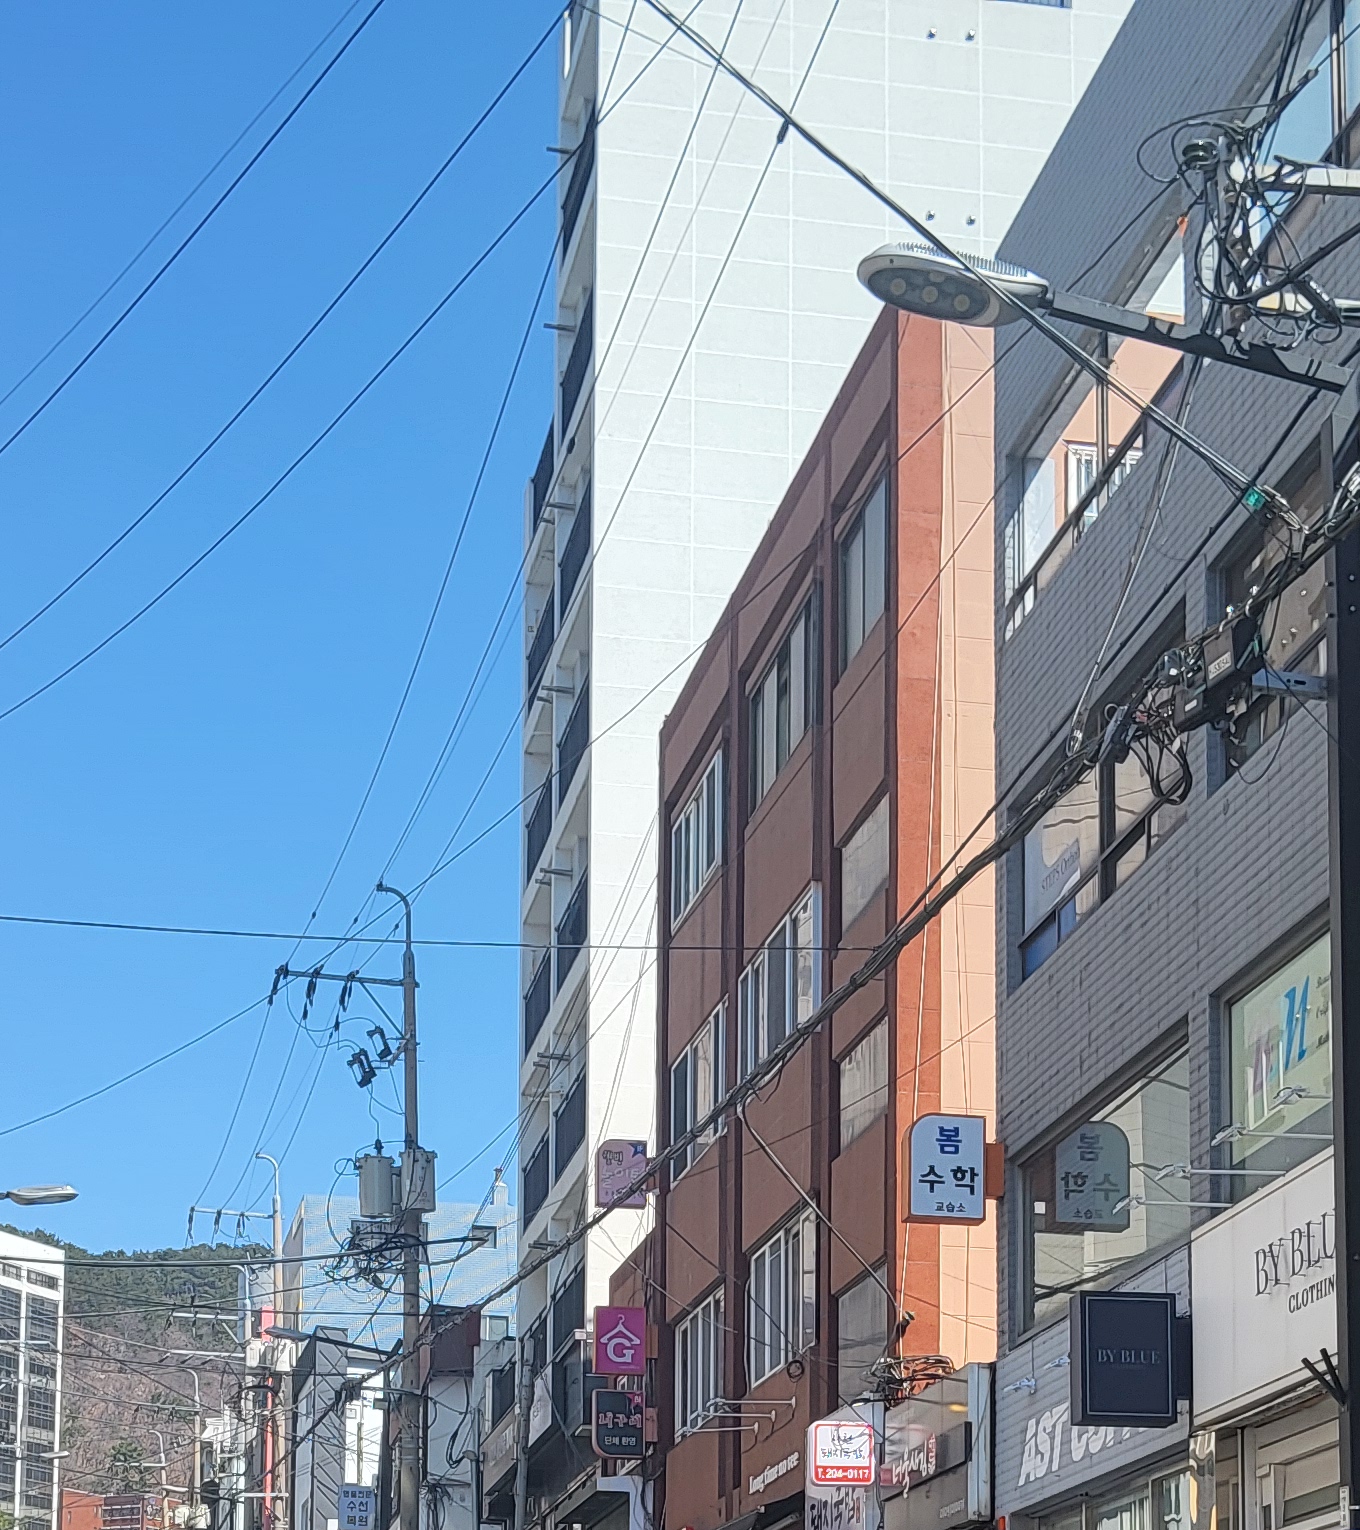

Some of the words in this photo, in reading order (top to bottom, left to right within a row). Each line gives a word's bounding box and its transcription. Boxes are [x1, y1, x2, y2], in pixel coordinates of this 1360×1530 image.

[935, 1125, 962, 1155] 봄
[918, 1165, 979, 1195] 수학
[935, 1202, 966, 1213] 교습소
[1255, 1238, 1285, 1296] BY
[1290, 1212, 1336, 1277] BLU
[1288, 1274, 1335, 1314] CLOTHIN
[1097, 1349, 1116, 1363] BY
[1121, 1350, 1160, 1365] BLUE
[1018, 1402, 1069, 1487] AST
[825, 1467, 870, 1480] 204-0117
[346, 1500, 369, 1513] 수선
